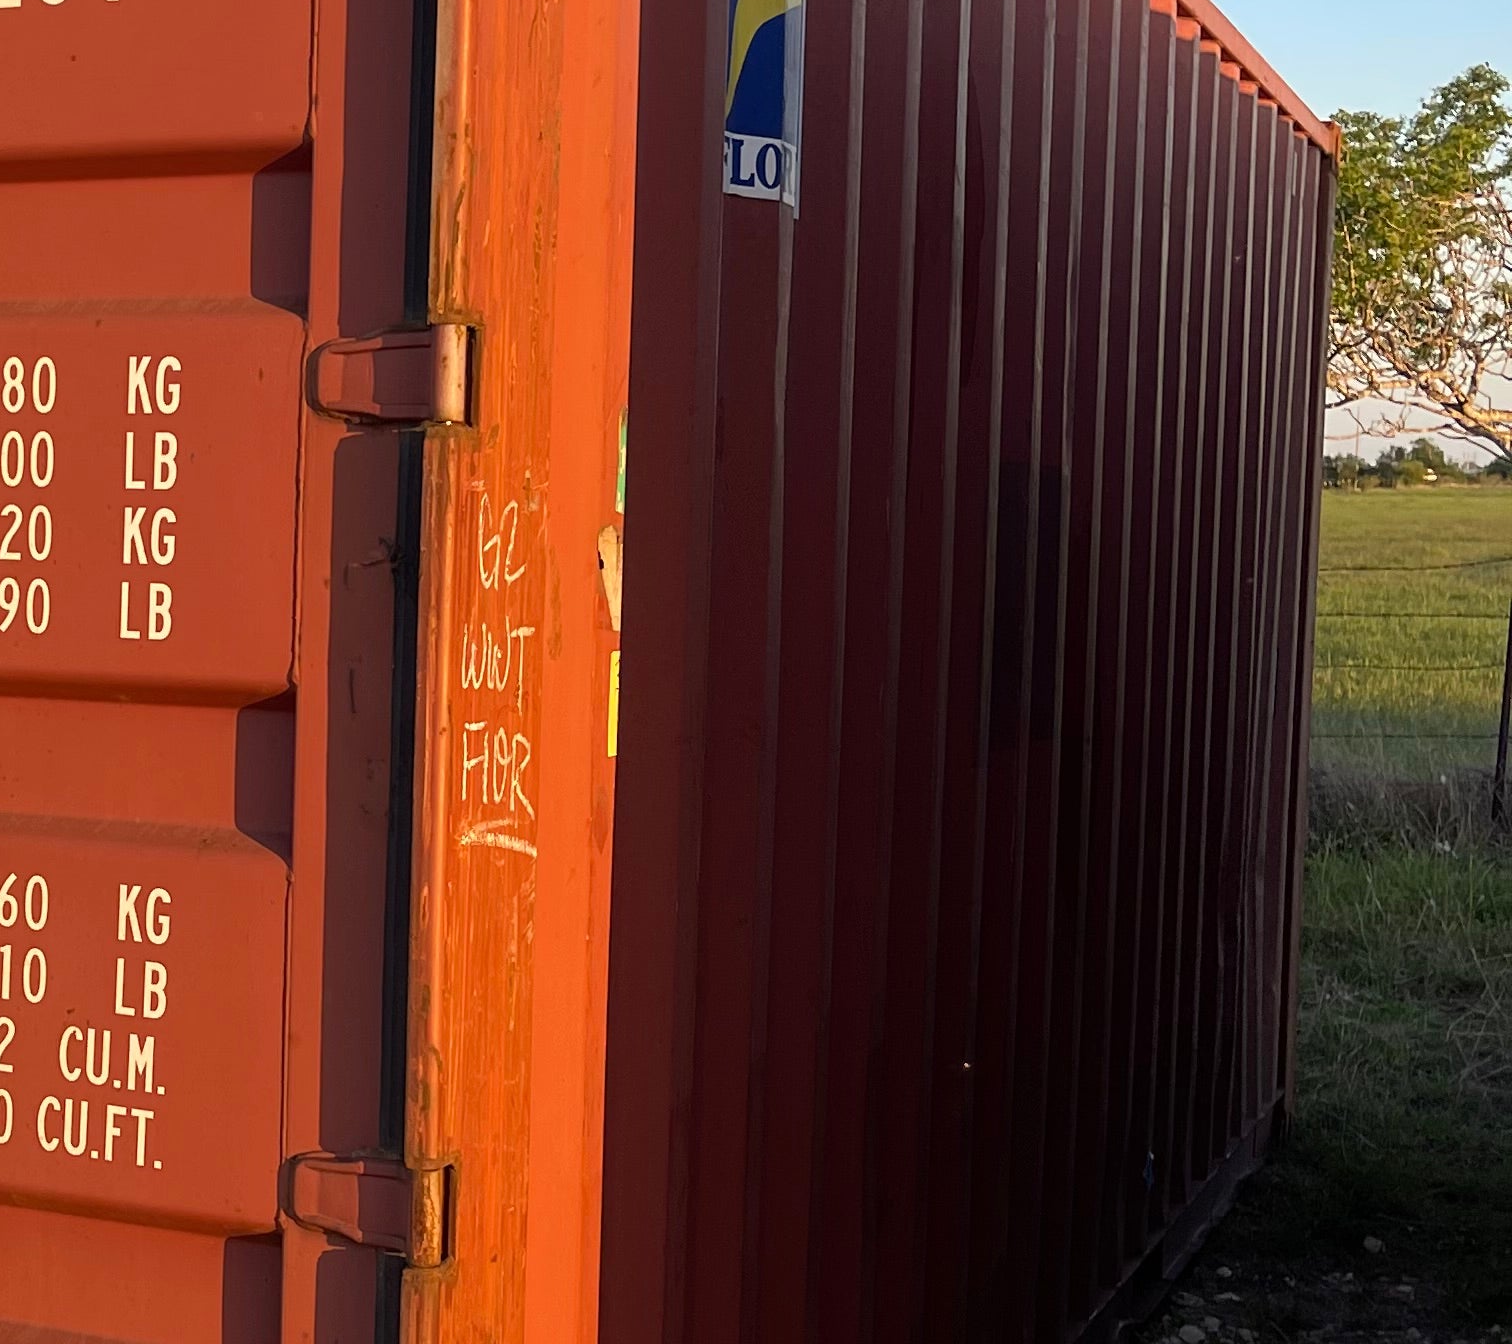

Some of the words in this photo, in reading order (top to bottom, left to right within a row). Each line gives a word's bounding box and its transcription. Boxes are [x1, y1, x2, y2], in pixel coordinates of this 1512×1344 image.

[127, 355, 182, 415] KG
[125, 431, 178, 490] LB
[122, 506, 177, 566] KG
[119, 581, 172, 641] LB
[117, 883, 172, 945] KG
[114, 957, 167, 1019] LB
[59, 1025, 167, 1095] CU.M.
[36, 1095, 164, 1170] CU.FT.
